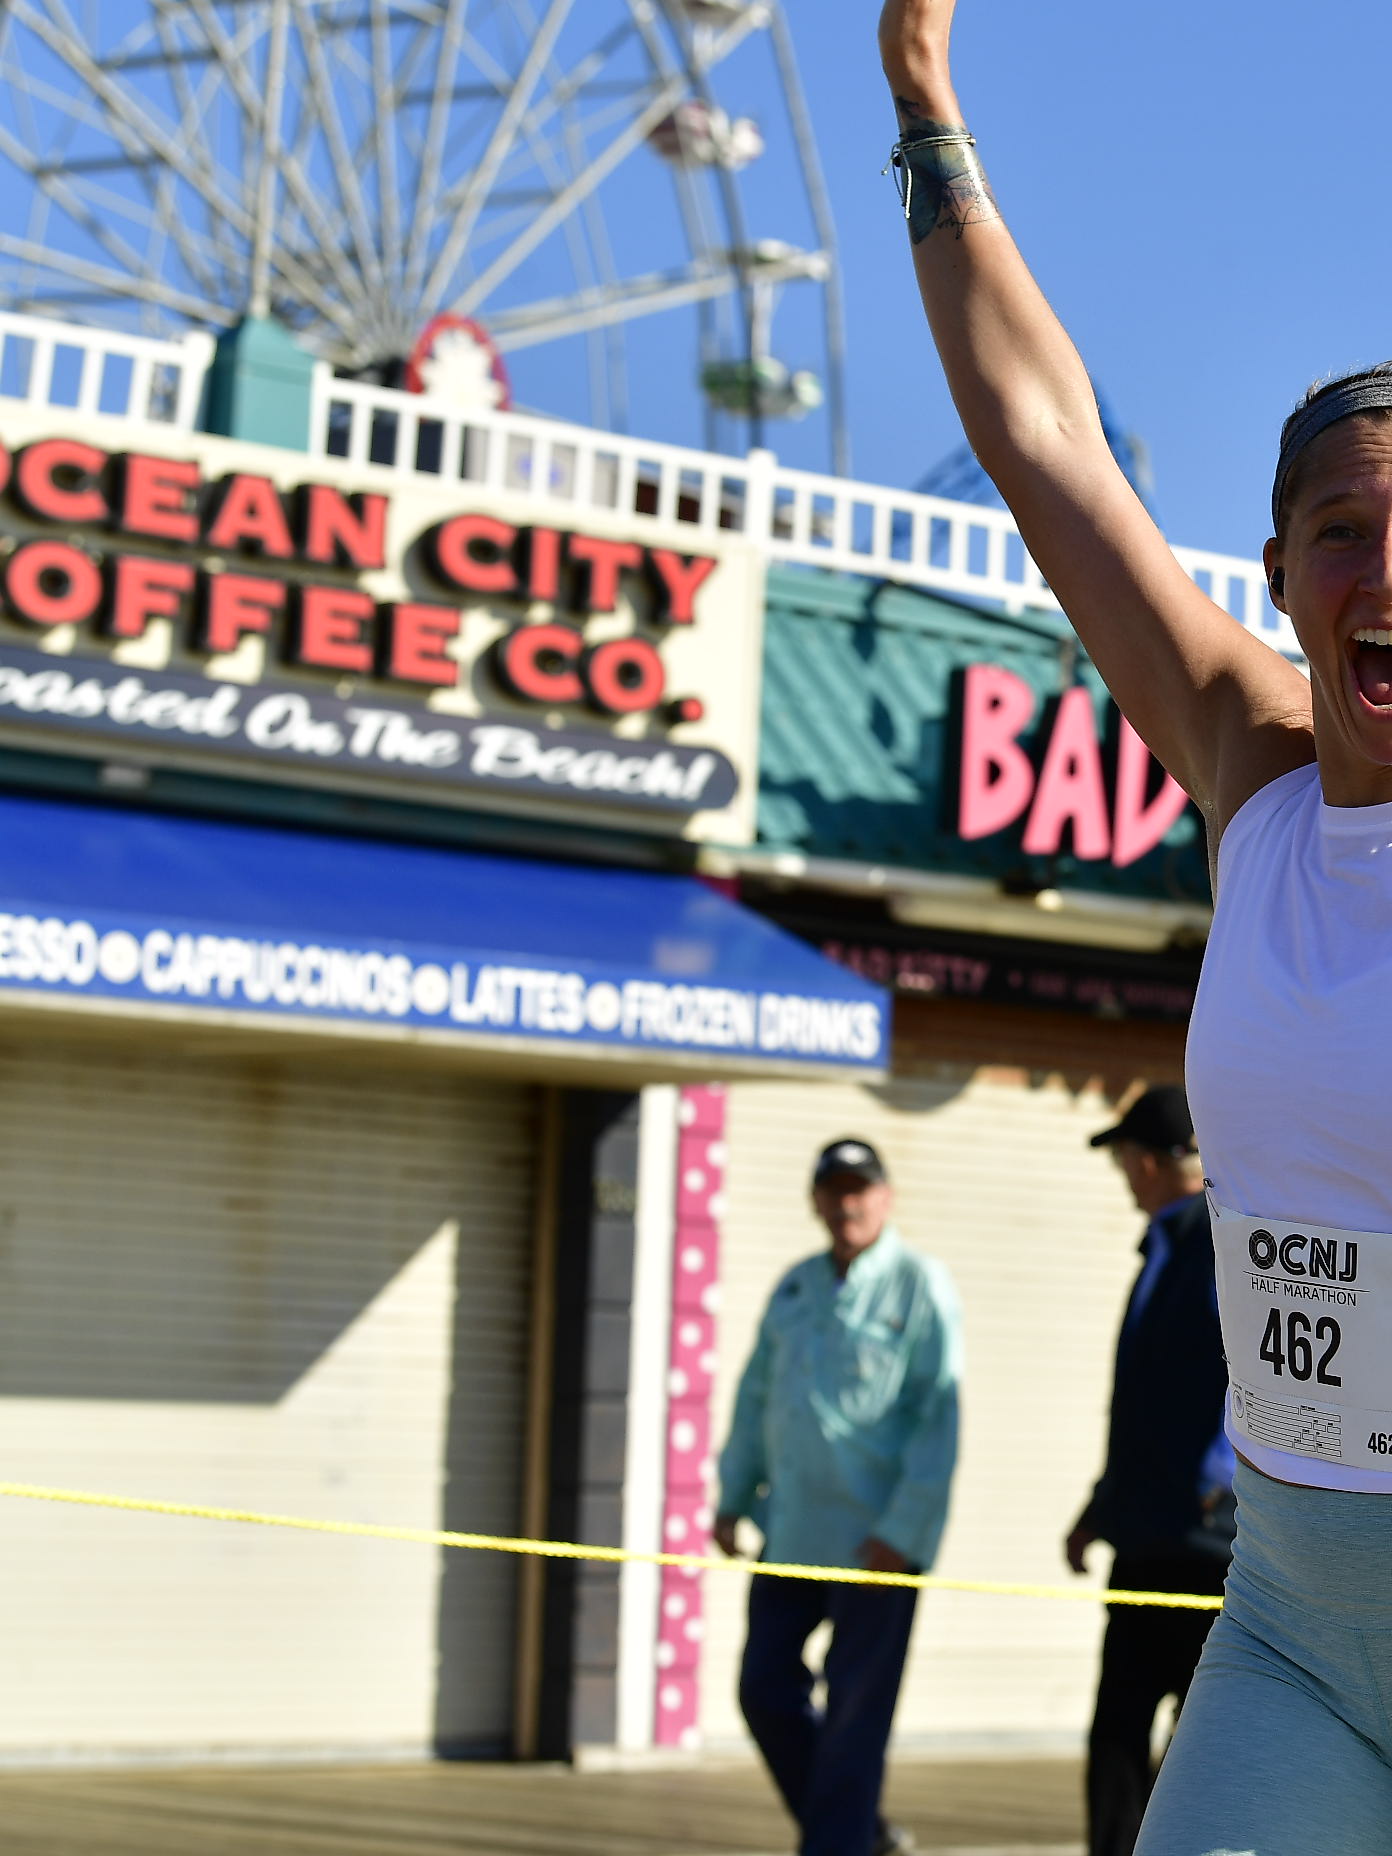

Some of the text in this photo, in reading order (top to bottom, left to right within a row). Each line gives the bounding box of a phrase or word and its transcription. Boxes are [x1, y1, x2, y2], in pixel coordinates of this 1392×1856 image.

[0, 437, 717, 624] CEAN CITY
[0, 541, 704, 722] OFFEE CO.
[245, 694, 343, 757] On
[347, 706, 459, 769] The
[470, 725, 714, 800] Beach!
[958, 663, 1189, 867] BAD
[142, 930, 410, 1015] CAPPUCCINOS
[451, 961, 583, 1032] LATTES
[620, 981, 756, 1045] FROZEN
[760, 993, 880, 1059] DRINKS
[1249, 1229, 1358, 1282] OCNJ
[1251, 1277, 1356, 1306] HALF MARATHON
[1260, 1308, 1341, 1387] 462
